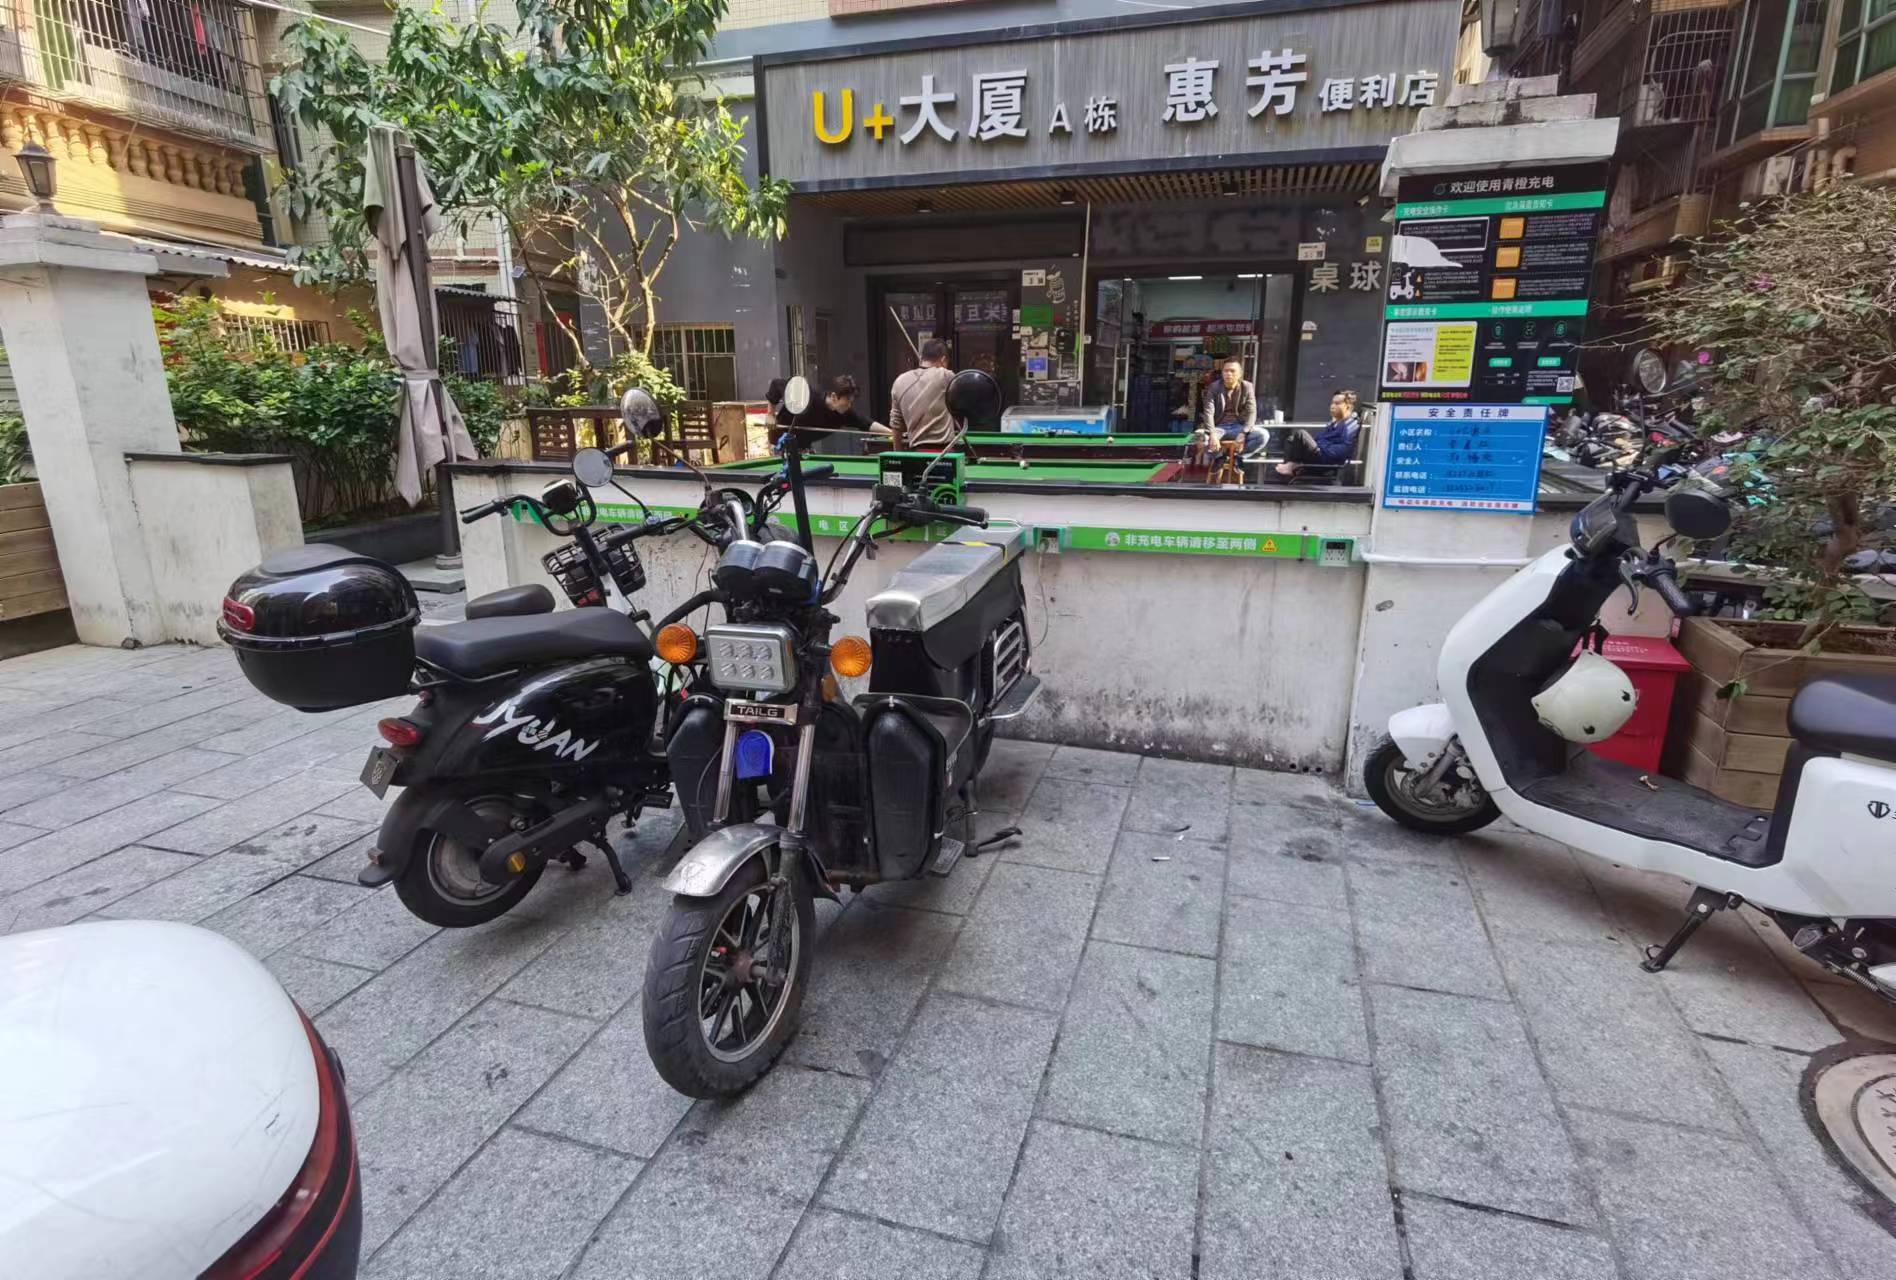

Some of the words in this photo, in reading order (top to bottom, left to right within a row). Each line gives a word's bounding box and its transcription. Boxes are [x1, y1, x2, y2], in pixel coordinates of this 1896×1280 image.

[1162, 48, 1308, 122] 惠芳
[1318, 70, 1439, 113] 便利店
[1450, 176, 1555, 194] 欢迎使用青橙充电
[1309, 261, 1382, 293] 桌球
[1428, 407, 1510, 418] 安全责任牌
[1125, 534, 1257, 550] 非充电车辆请移至两侧
[737, 705, 779, 718] TAILG
